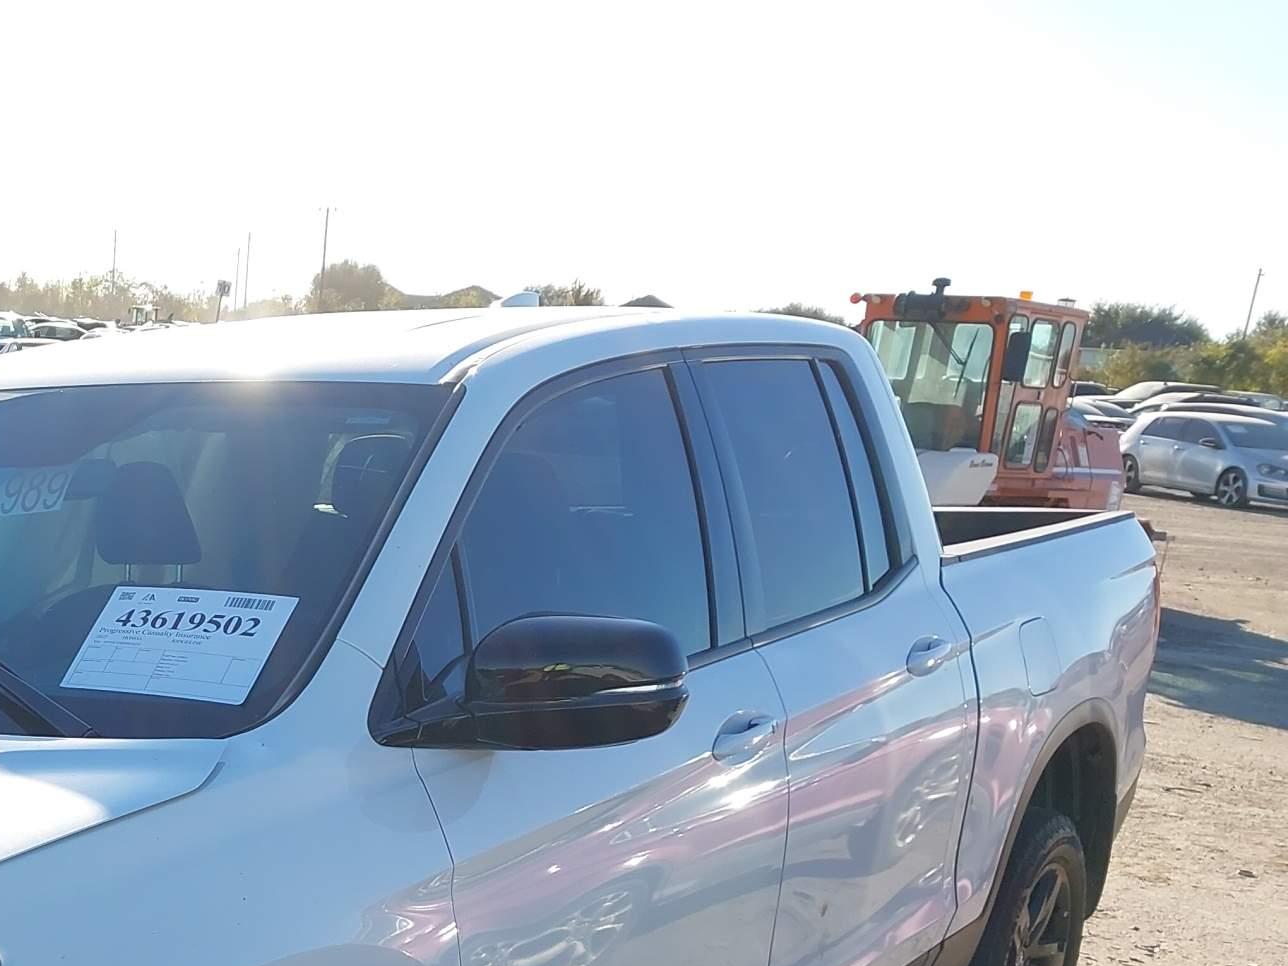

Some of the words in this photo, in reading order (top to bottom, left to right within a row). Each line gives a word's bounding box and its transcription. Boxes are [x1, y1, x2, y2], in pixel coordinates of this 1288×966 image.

[115, 608, 261, 637] 43619502
[99, 627, 141, 636] Progressive
[142, 629, 173, 638] Casualty
[175, 631, 212, 640] Insurance
